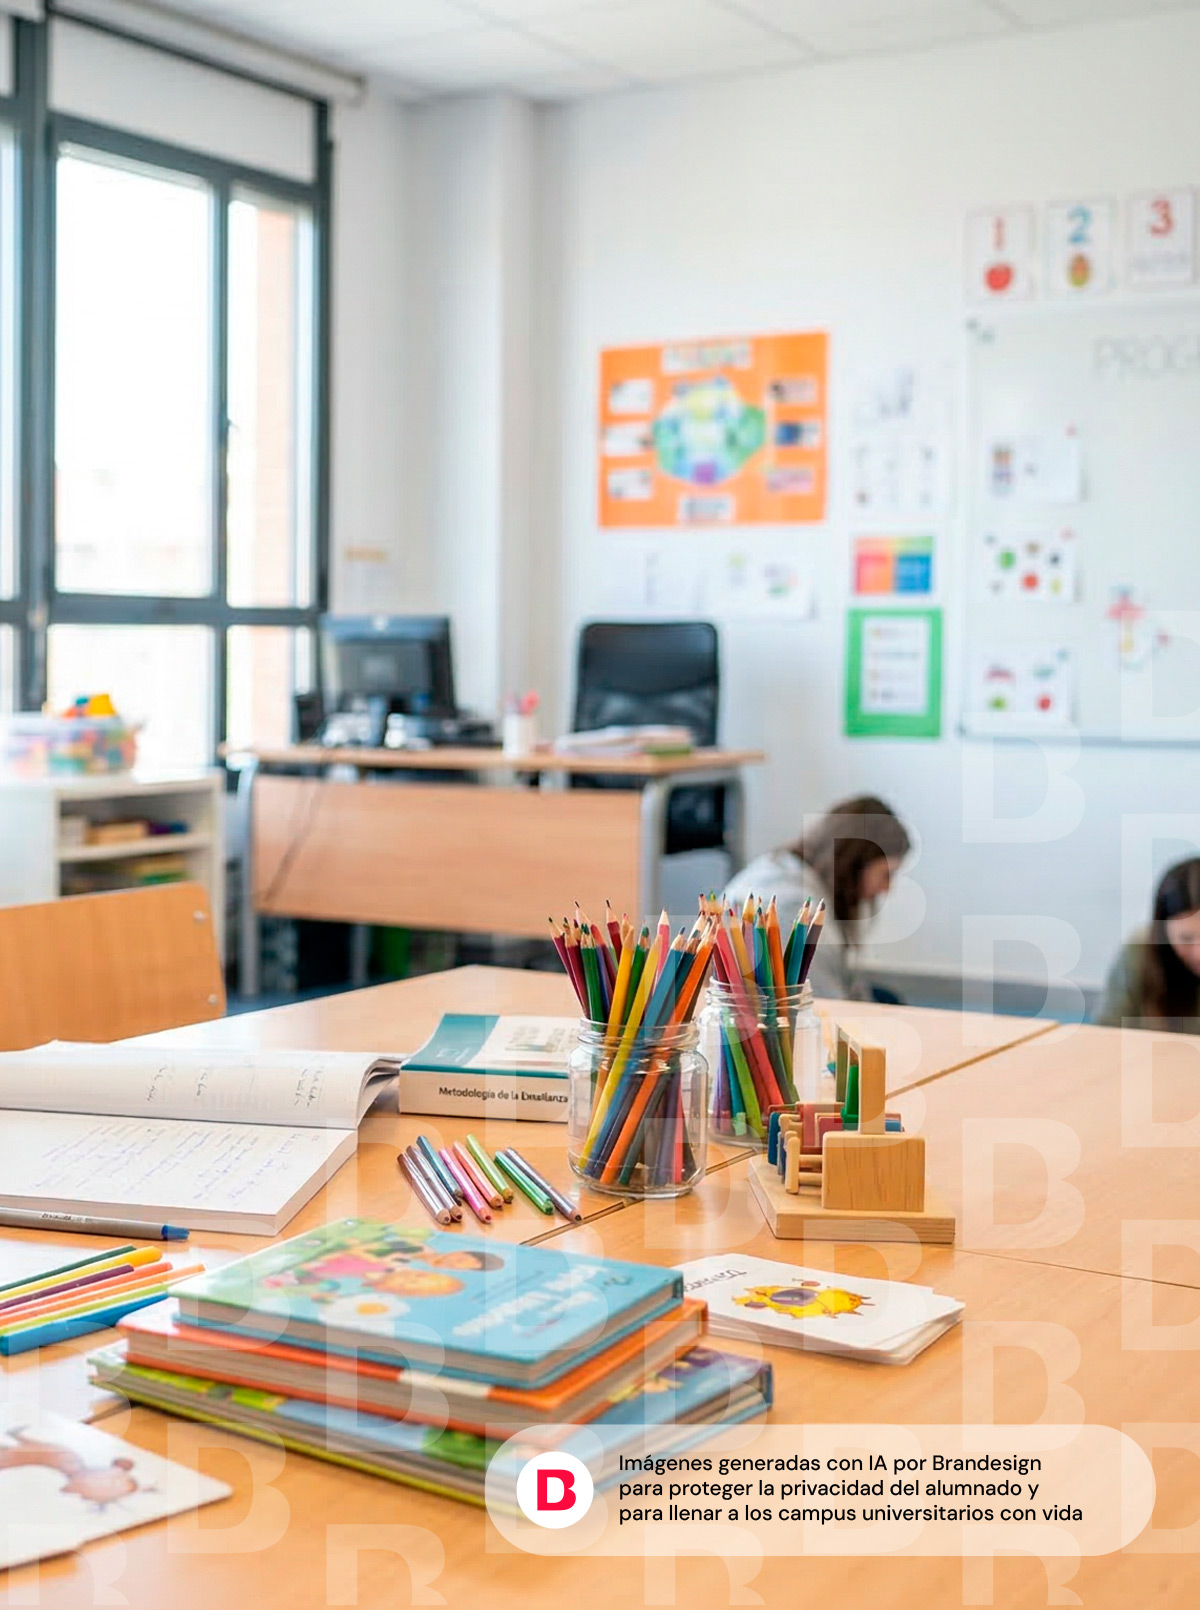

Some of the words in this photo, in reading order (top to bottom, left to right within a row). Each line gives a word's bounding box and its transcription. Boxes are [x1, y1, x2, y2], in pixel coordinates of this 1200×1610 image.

[1067, 206, 1092, 245] 2
[1148, 198, 1174, 238] 3
[497, 1090, 509, 1100] de
